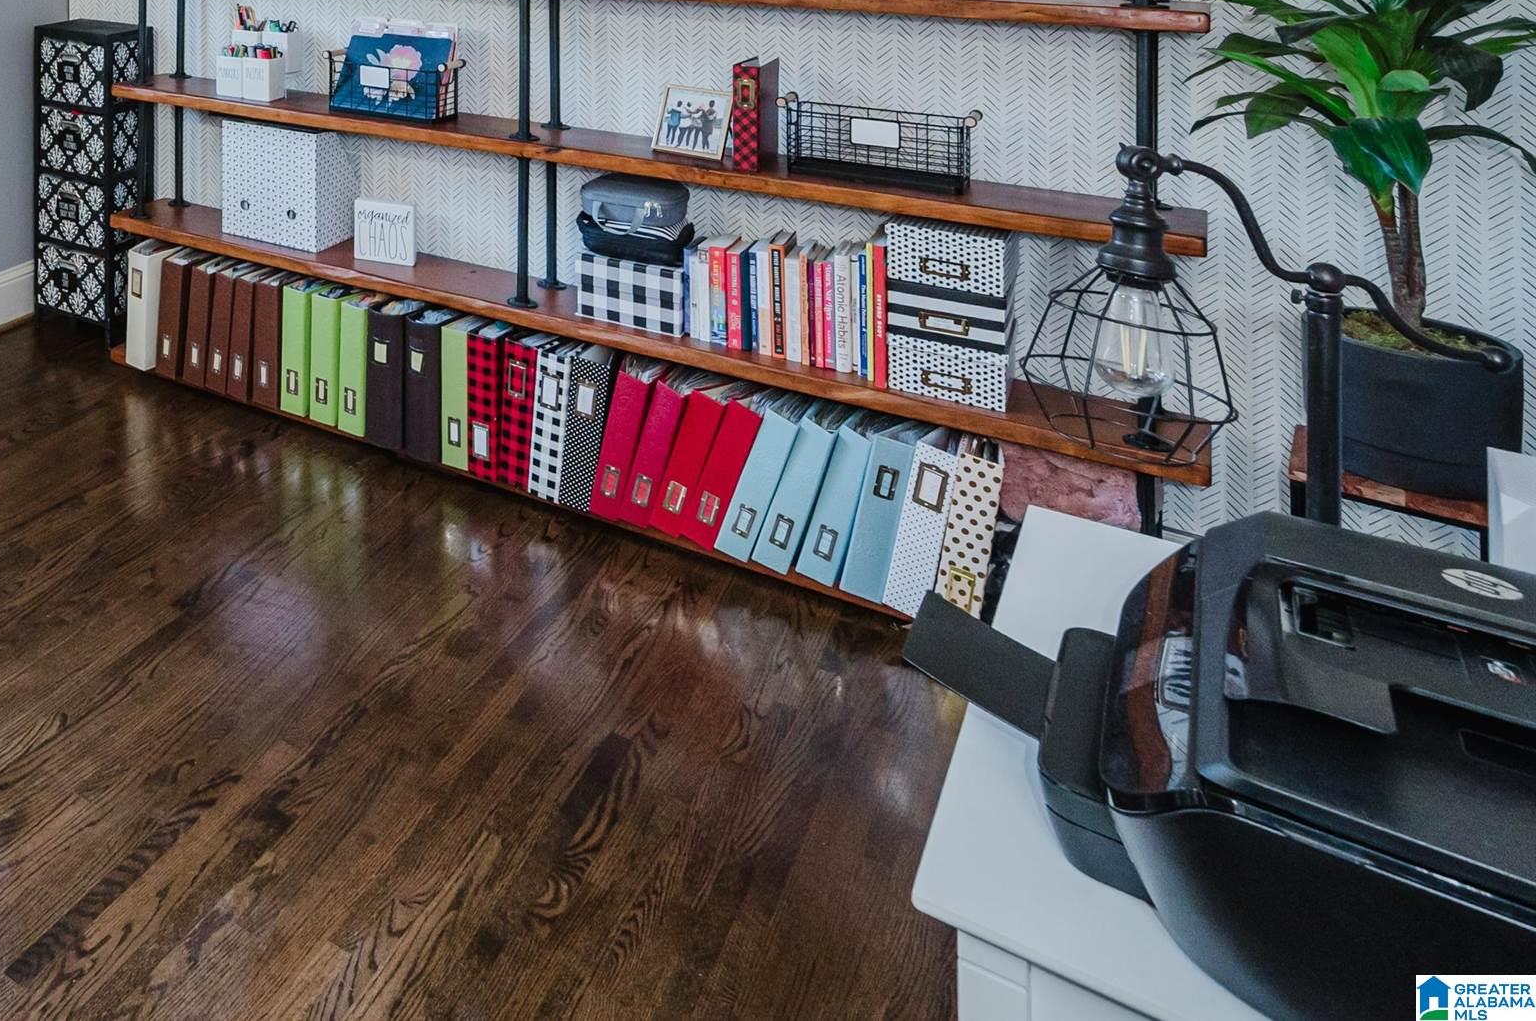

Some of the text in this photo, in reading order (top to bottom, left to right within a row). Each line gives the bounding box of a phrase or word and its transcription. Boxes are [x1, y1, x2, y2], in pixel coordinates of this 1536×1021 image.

[357, 209, 411, 226] organized
[359, 220, 408, 261] CHAOS
[836, 274, 847, 312] Atomic
[837, 315, 849, 349] Habits
